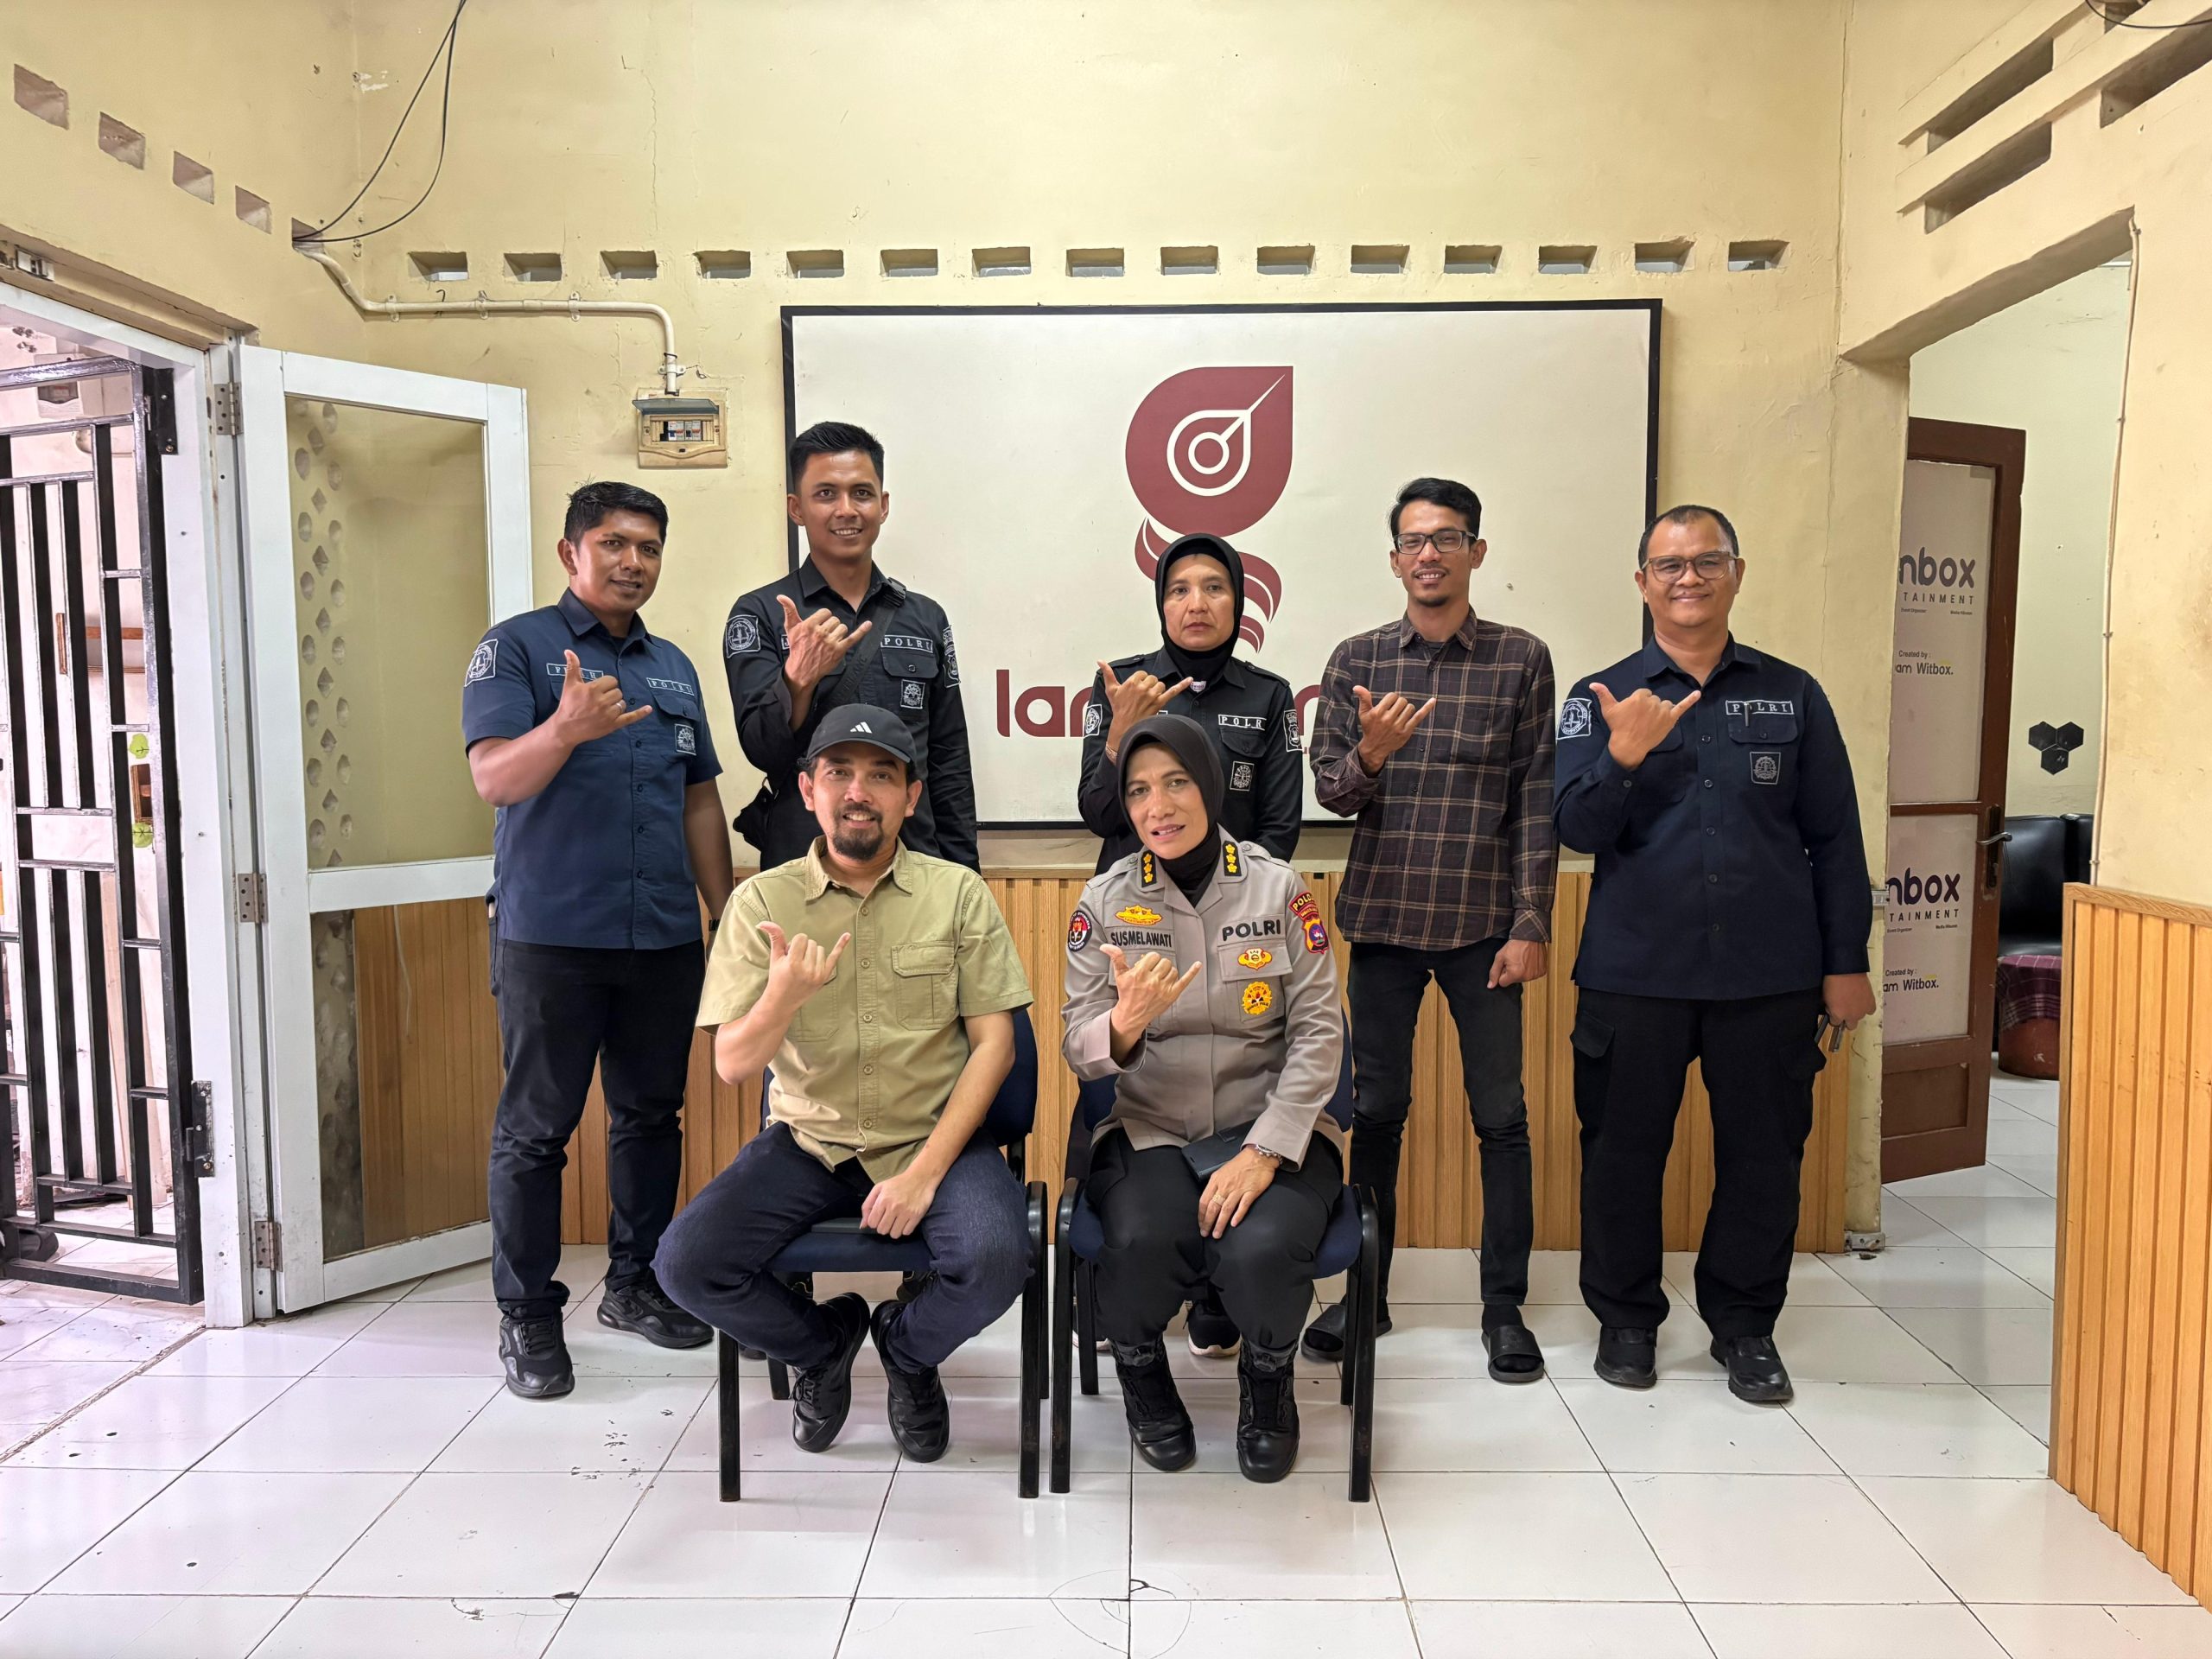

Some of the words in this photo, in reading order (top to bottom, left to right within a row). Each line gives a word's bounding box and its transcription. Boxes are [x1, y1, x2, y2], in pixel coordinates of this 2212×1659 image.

[1898, 546, 1976, 588] nbox
[1903, 592, 1974, 605] TAINMENT
[884, 638, 931, 651] POLRI
[1920, 651, 1928, 659] by
[1916, 662, 1954, 675] Witbox.
[1732, 702, 1788, 713] PLRI
[1889, 908, 1960, 923] TAINMENT
[1222, 918, 1281, 942] POLRI
[1110, 931, 1172, 948] SUSMELAWATI
[1907, 968, 1914, 976] by
[1903, 977, 1939, 991] Witbox.
